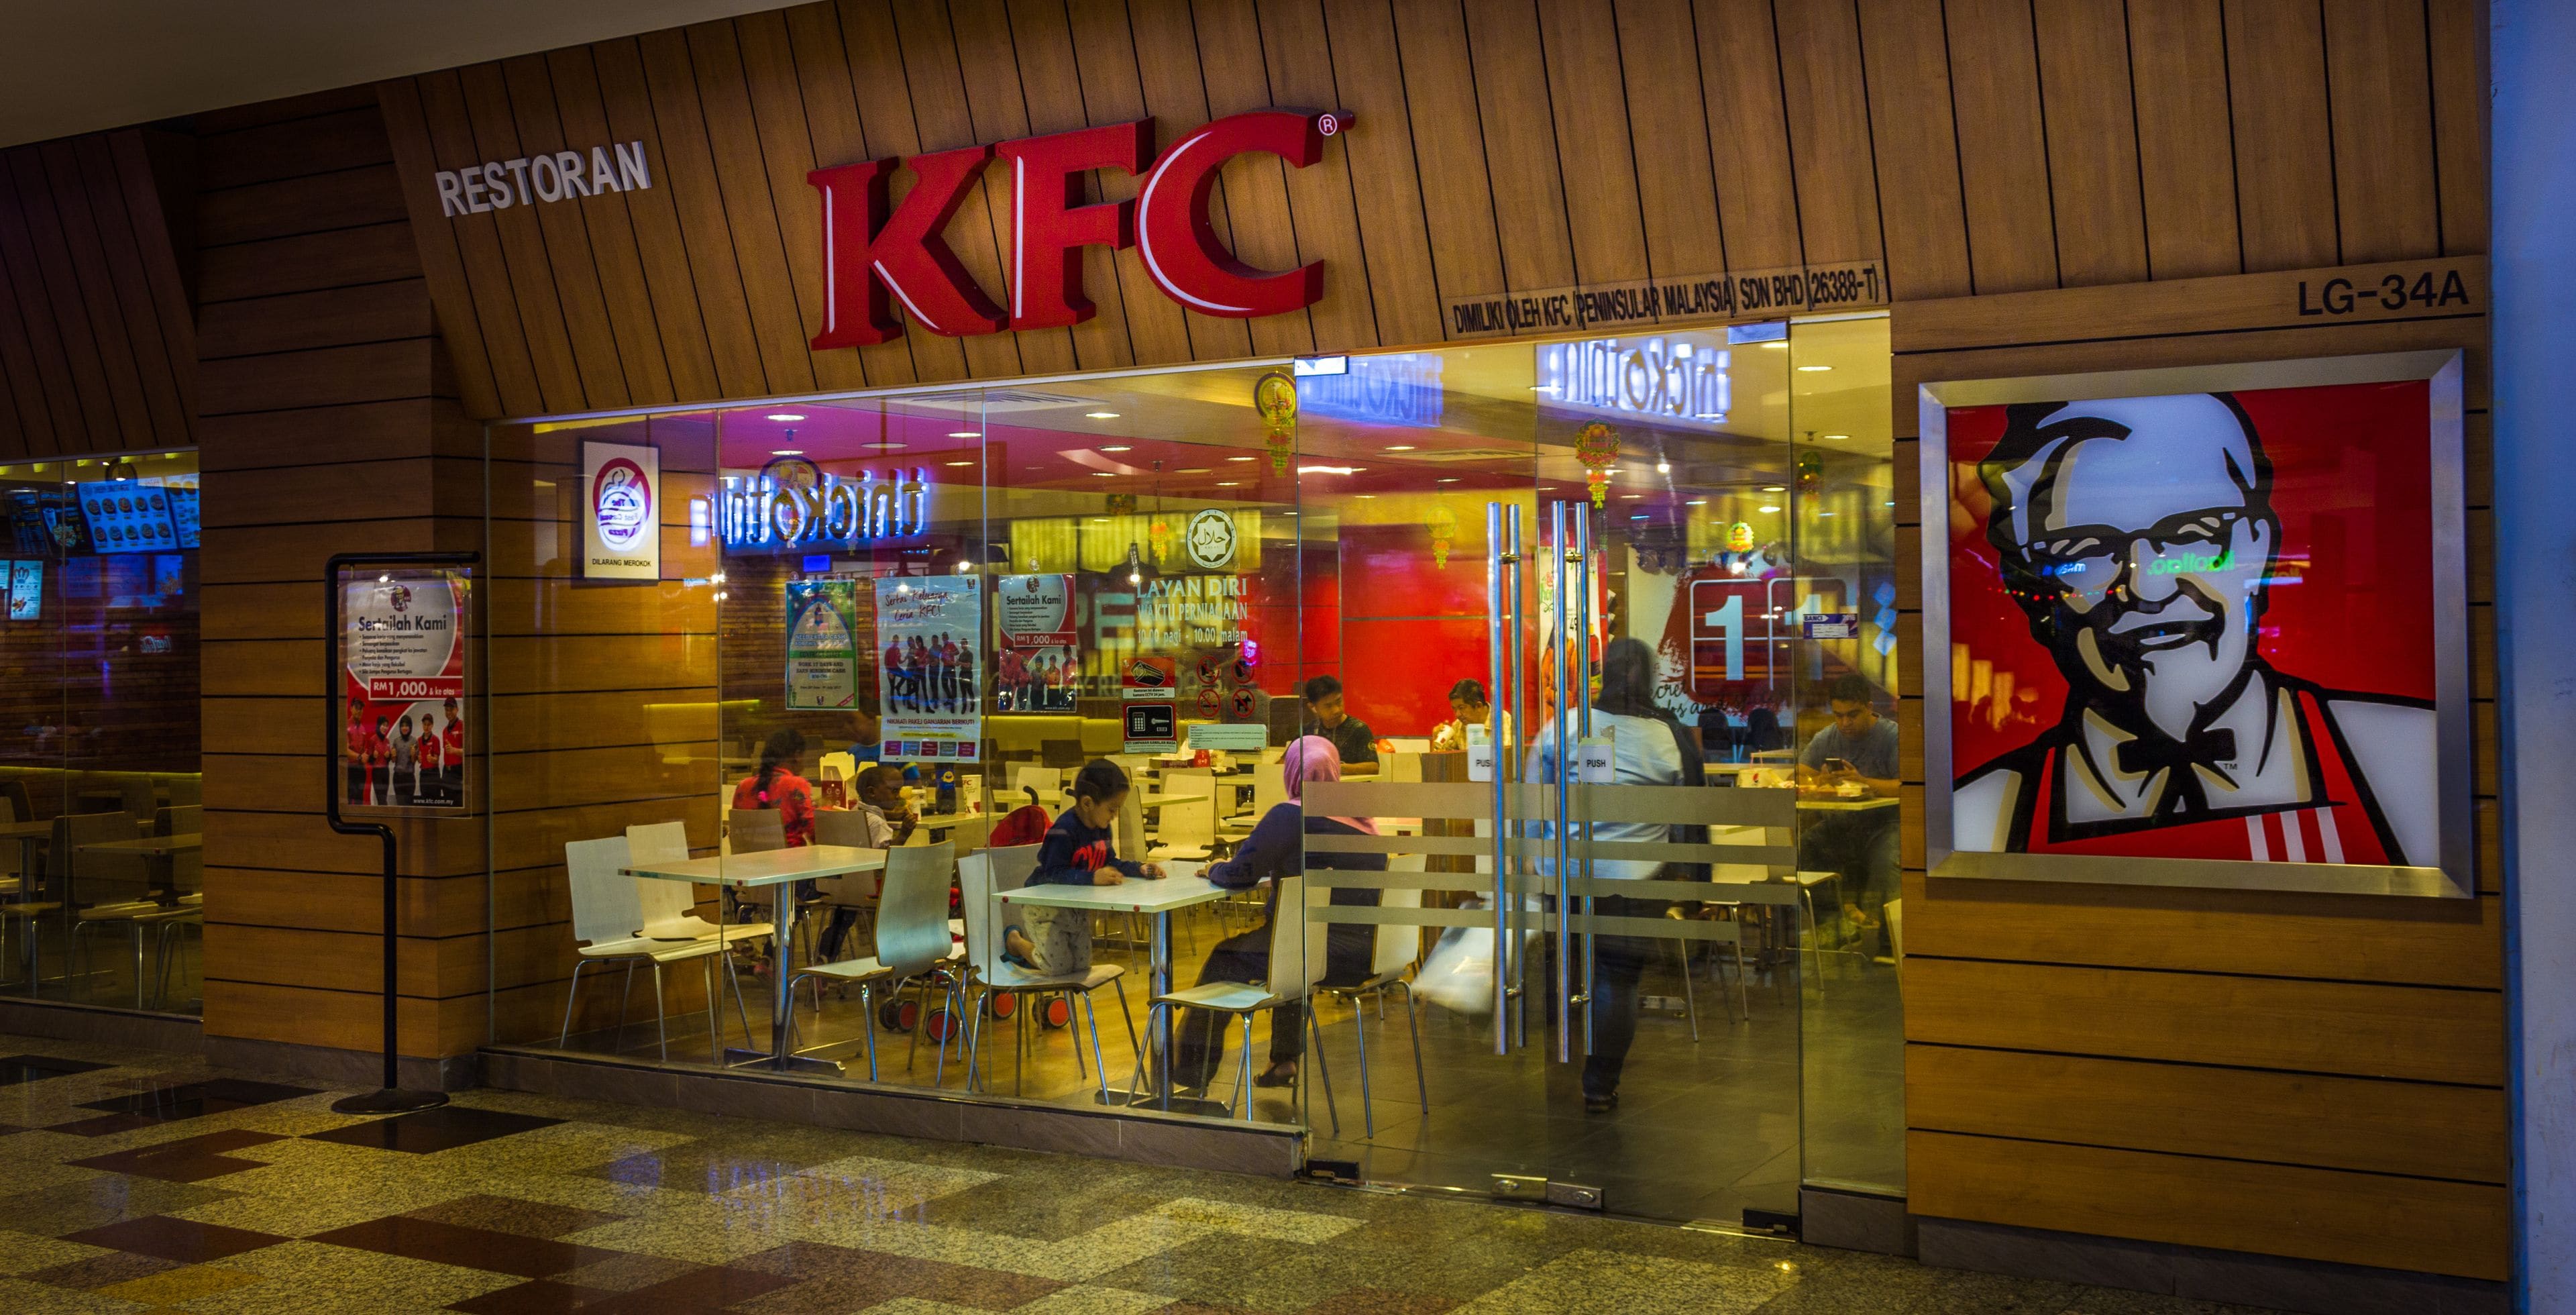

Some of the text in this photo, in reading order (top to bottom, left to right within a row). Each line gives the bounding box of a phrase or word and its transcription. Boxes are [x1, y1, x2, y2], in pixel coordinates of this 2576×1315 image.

[435, 141, 652, 217] RESTORAN
[806, 107, 1324, 351] KFC
[1453, 264, 1878, 333] DIMILIKI OLEH KFC (PENINSULAR MALAYSIA) SDN BHD (26388-T)
[2299, 270, 2469, 316] LG-34A
[623, 559, 651, 567] MEROKOK
[1137, 578, 1247, 598] LAYAN DIRI
[1006, 594, 1061, 605] Sertailah Kami
[1138, 603, 1175, 621] WAKTU
[358, 615, 447, 631] Sertailah Kami
[1138, 628, 1159, 643] 10.00
[1164, 629, 1181, 645] pagi
[1194, 627, 1215, 643] 10.00
[1220, 627, 1248, 643] malam
[1476, 759, 1491, 767] PUS
[1587, 759, 1606, 768] PUSH
